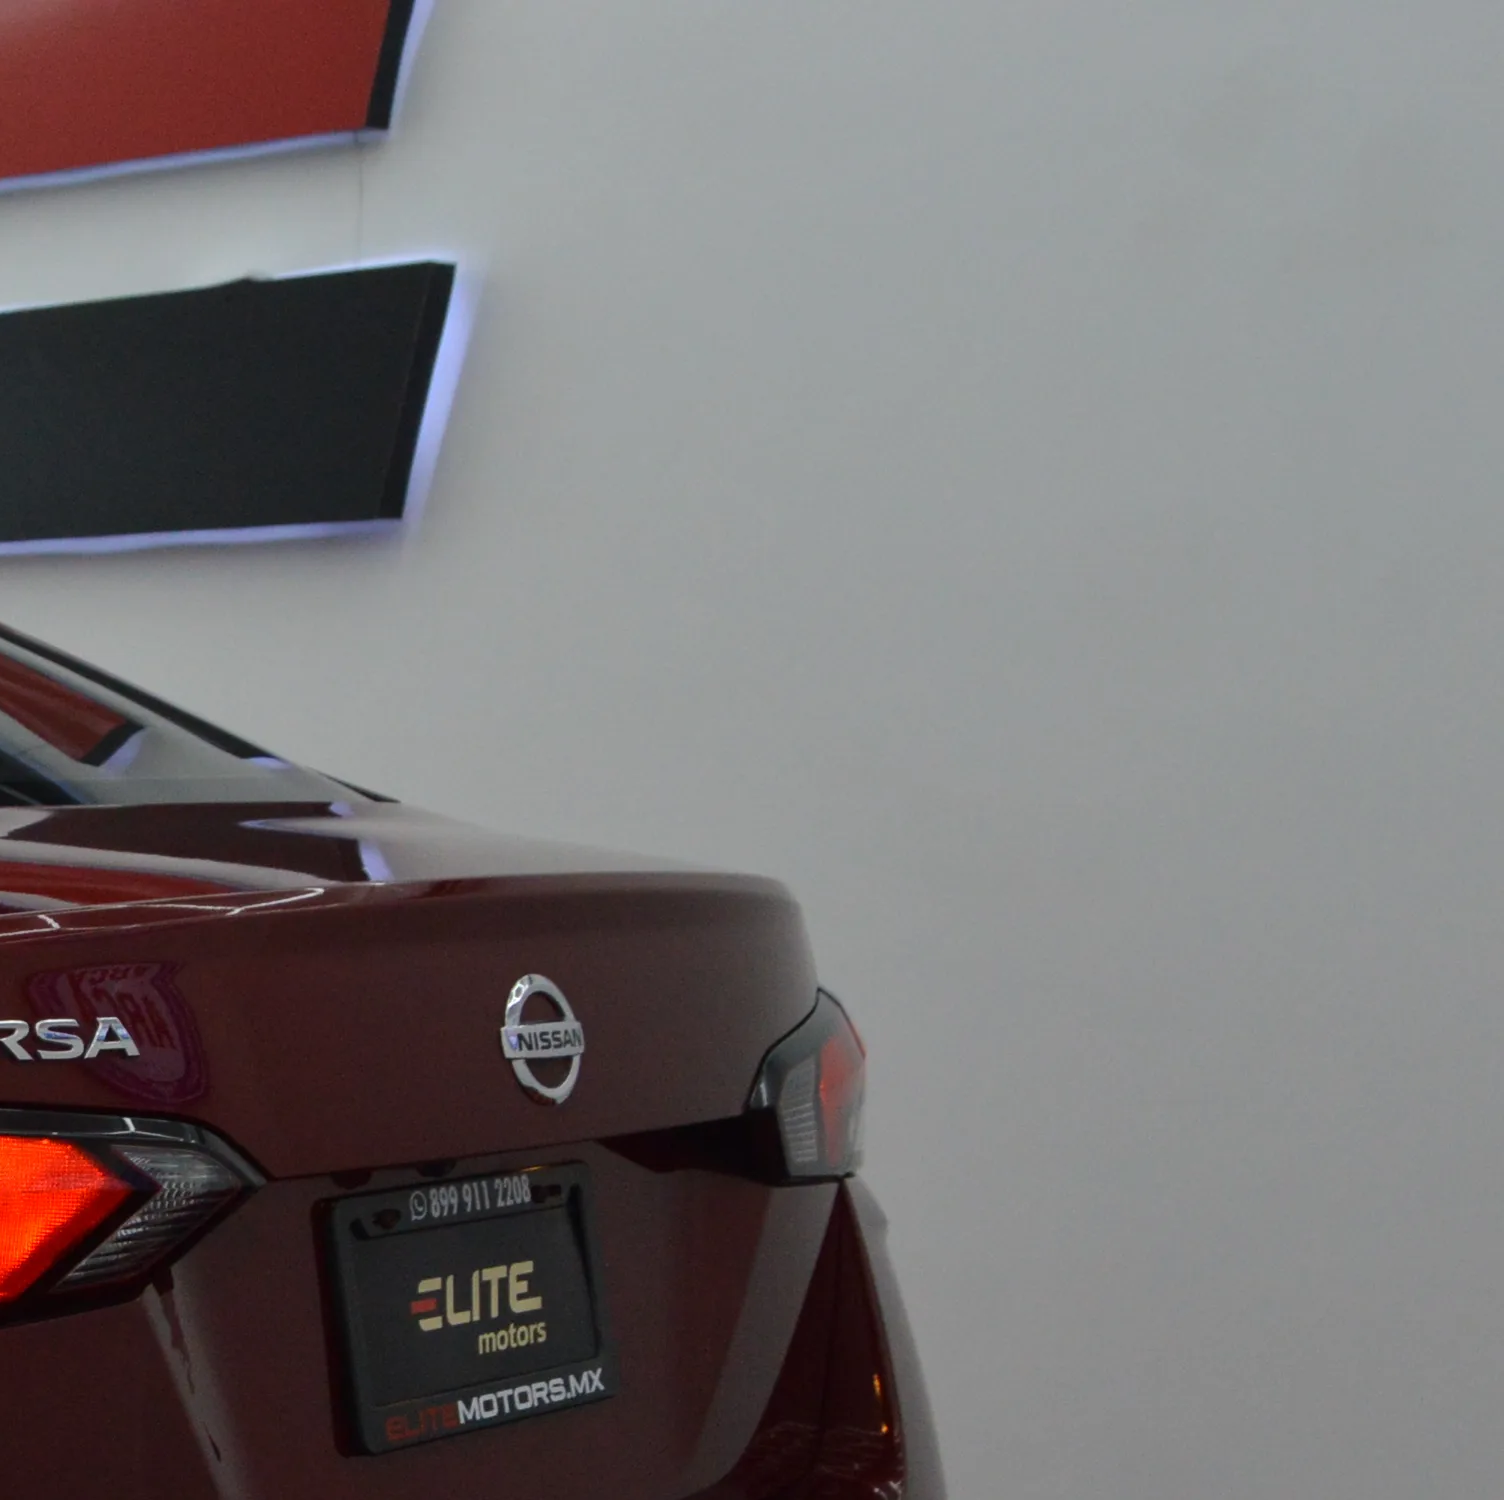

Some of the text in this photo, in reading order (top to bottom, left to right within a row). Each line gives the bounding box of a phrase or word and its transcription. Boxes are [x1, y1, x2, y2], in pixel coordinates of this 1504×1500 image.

[517, 1028, 582, 1051] NISSAN
[429, 1174, 532, 1219] 899 911 2208
[410, 1260, 542, 1332] ELITE
[478, 1322, 547, 1355] motors
